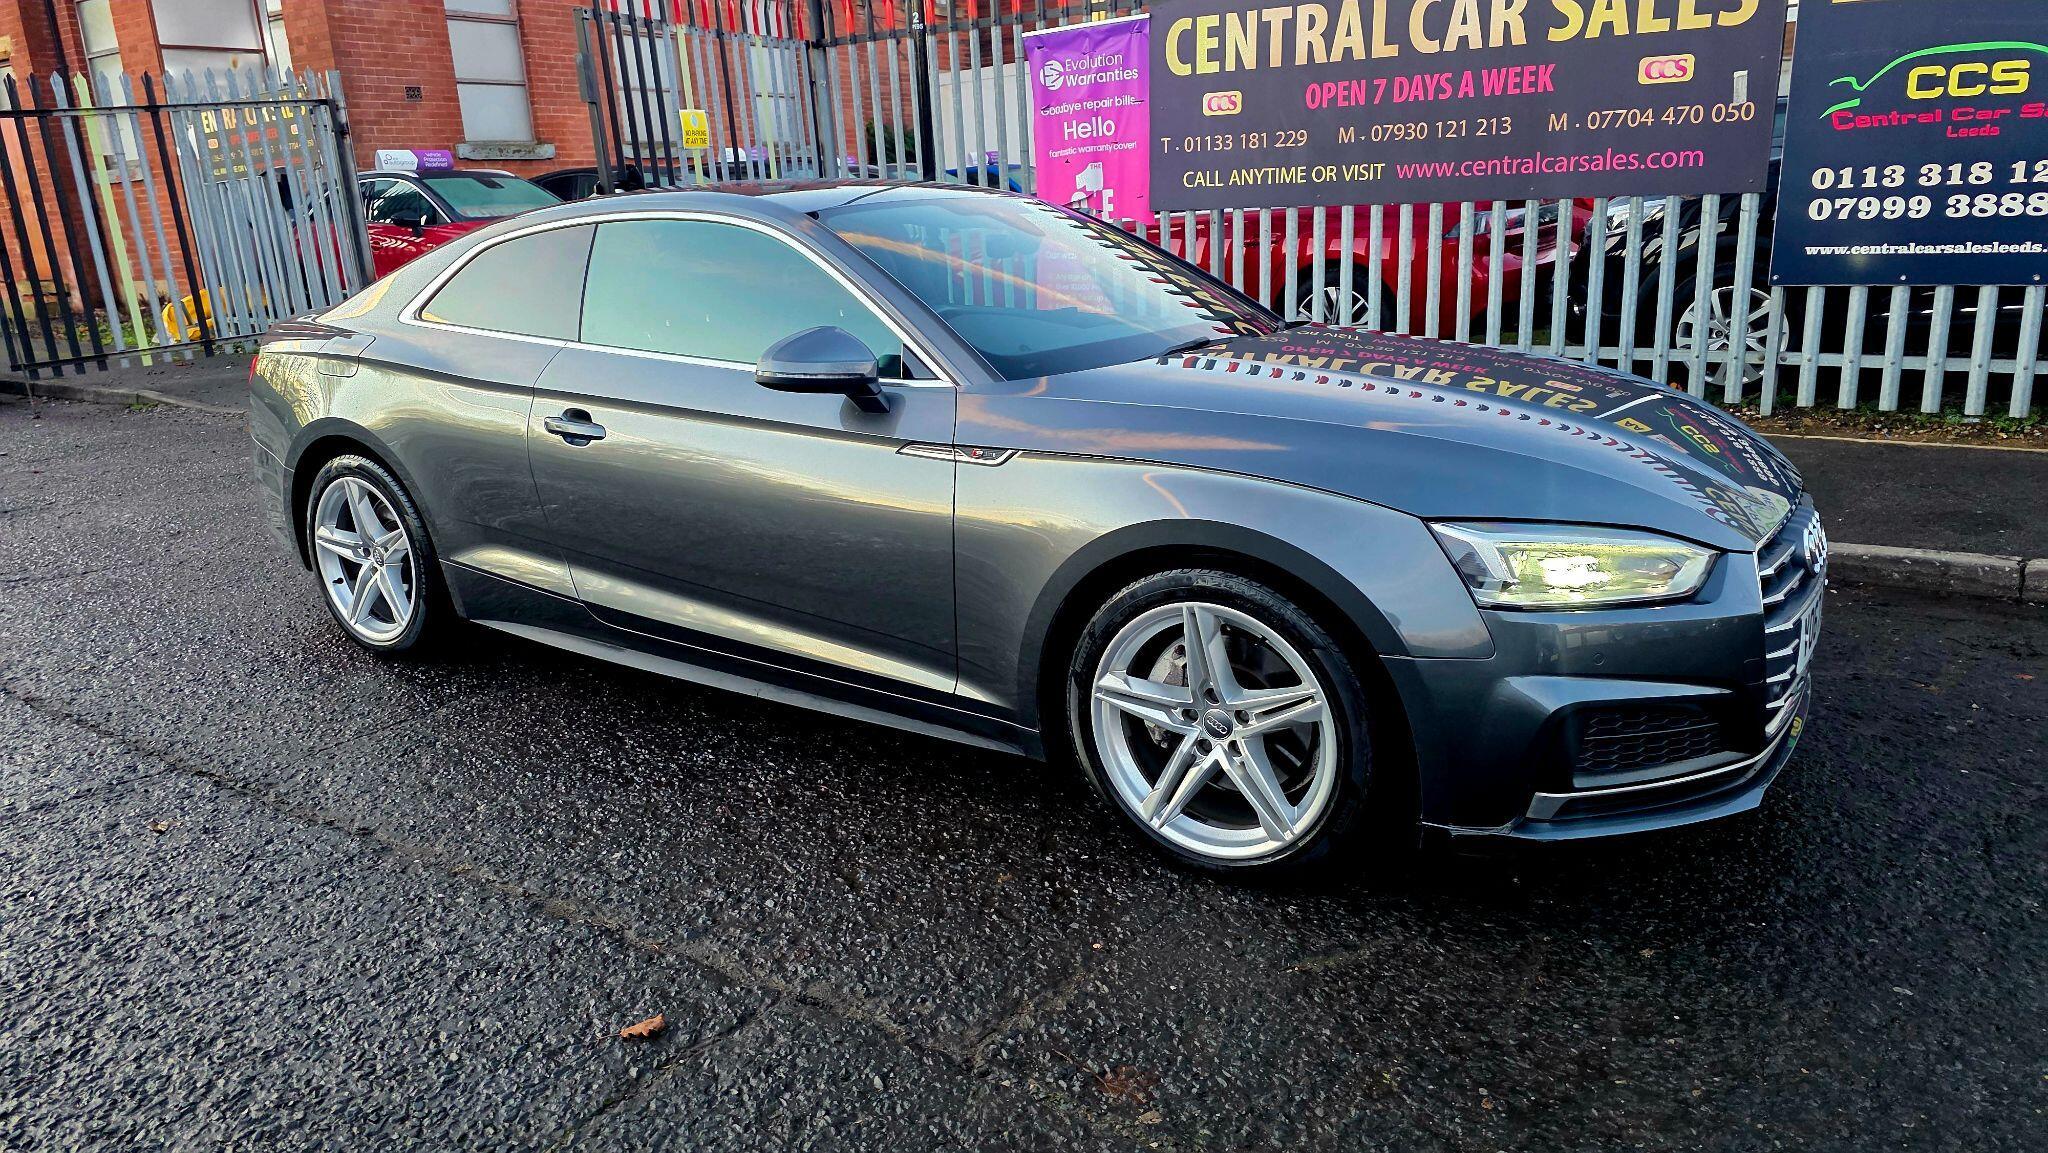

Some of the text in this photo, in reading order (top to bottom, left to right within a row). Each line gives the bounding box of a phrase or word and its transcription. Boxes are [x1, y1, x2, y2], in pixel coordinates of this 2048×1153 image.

[1166, 0, 1398, 76] CENTRAL
[1409, 0, 1527, 53] CAR
[1064, 53, 1122, 72] Evolution
[1644, 58, 1688, 80] CCS
[1066, 67, 1138, 87] Warranties
[1305, 64, 1556, 109] OPEN 7 DAYS A WEEK
[1906, 60, 2031, 99] CCS
[1083, 97, 1113, 113] repair
[1588, 108, 1655, 130] 07704
[1661, 105, 1704, 126] 470
[1712, 101, 1756, 123] 050
[1063, 116, 1116, 140] Hello
[1371, 122, 1428, 142] 07930
[1436, 119, 1467, 138] 121
[1476, 117, 1512, 136] 213
[1831, 109, 1942, 131] Central
[1951, 107, 2011, 121] Car
[1946, 124, 2000, 138] Leeds
[1078, 143, 1113, 156] warranty
[1113, 141, 1137, 151] cover!
[1184, 134, 1233, 153] 01133
[1240, 132, 1269, 150] 181
[1275, 129, 1308, 147] 229
[1183, 148, 1705, 188] CALL ANYTIME OR VISIT www.centralcarsales.com
[1811, 165, 1906, 190] 0113
[1918, 161, 1993, 187] 318
[1808, 192, 2048, 221] 07999 3888
